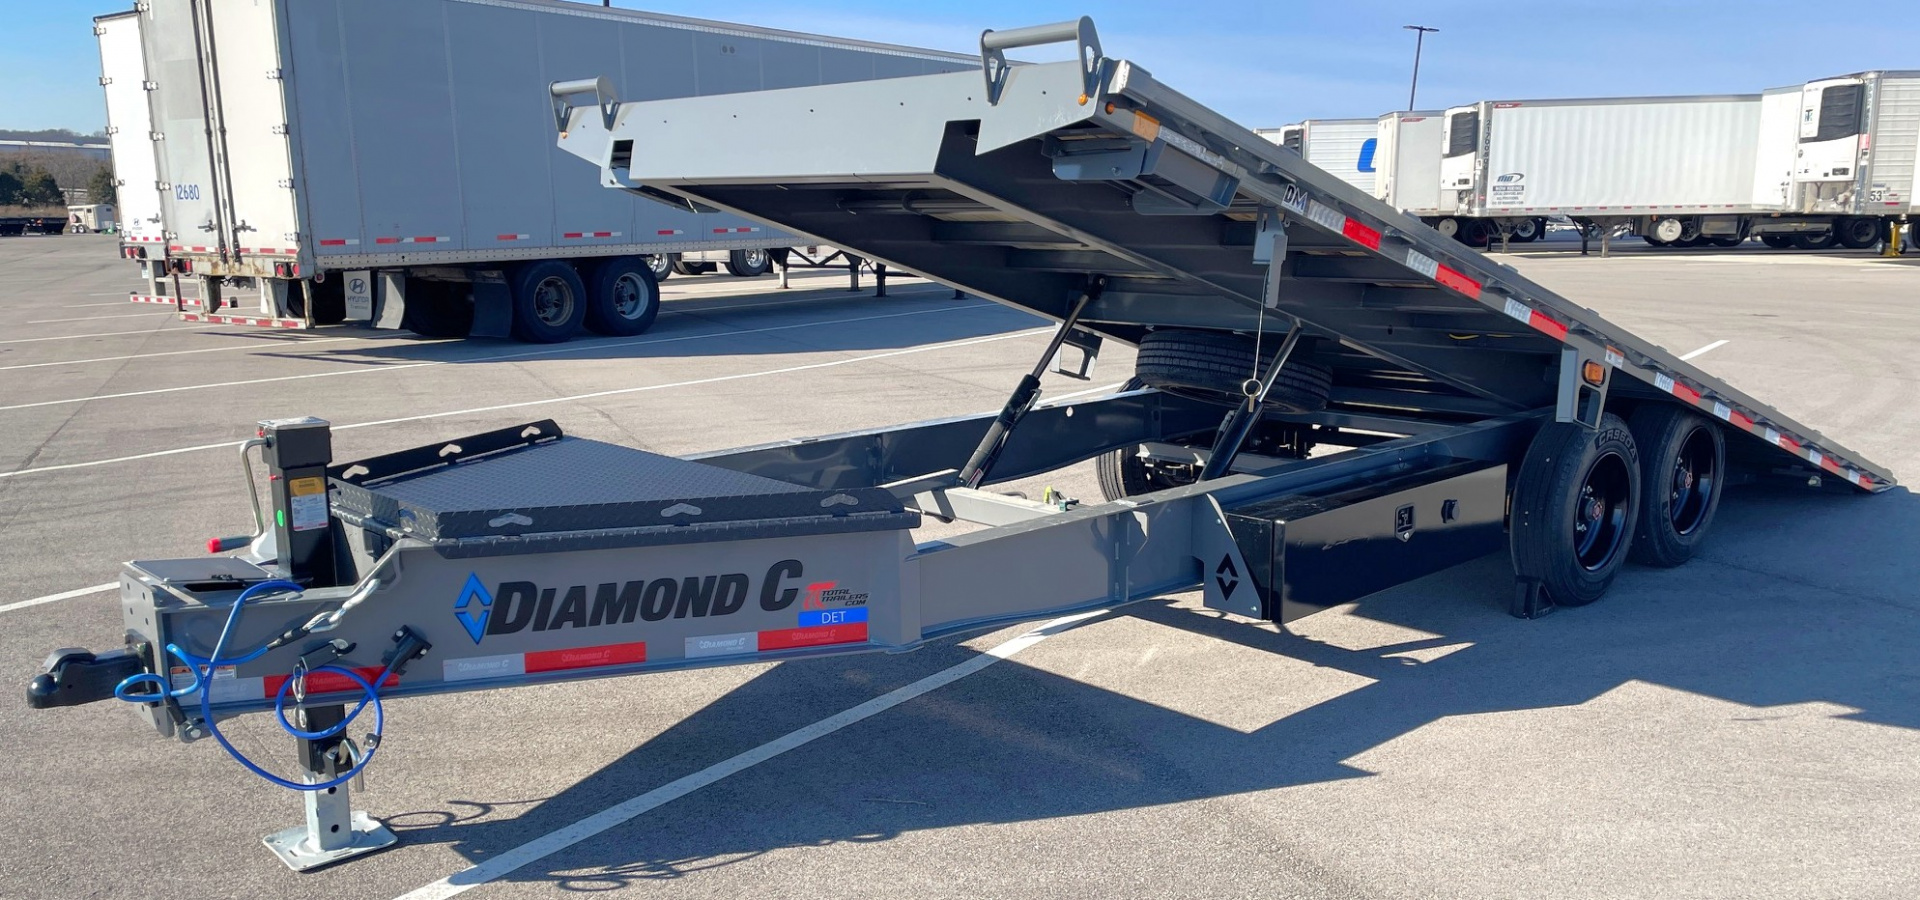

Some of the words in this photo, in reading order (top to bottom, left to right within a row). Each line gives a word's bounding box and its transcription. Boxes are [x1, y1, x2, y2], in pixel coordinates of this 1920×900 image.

[175, 184, 200, 200] 12680
[1282, 183, 1308, 211] DM
[485, 573, 750, 636] DIAMOND
[759, 559, 804, 612] C
[821, 593, 869, 602] TRAILERS
[822, 589, 851, 597] TOTAL
[821, 611, 847, 624] DET
[738, 637, 746, 646] C
